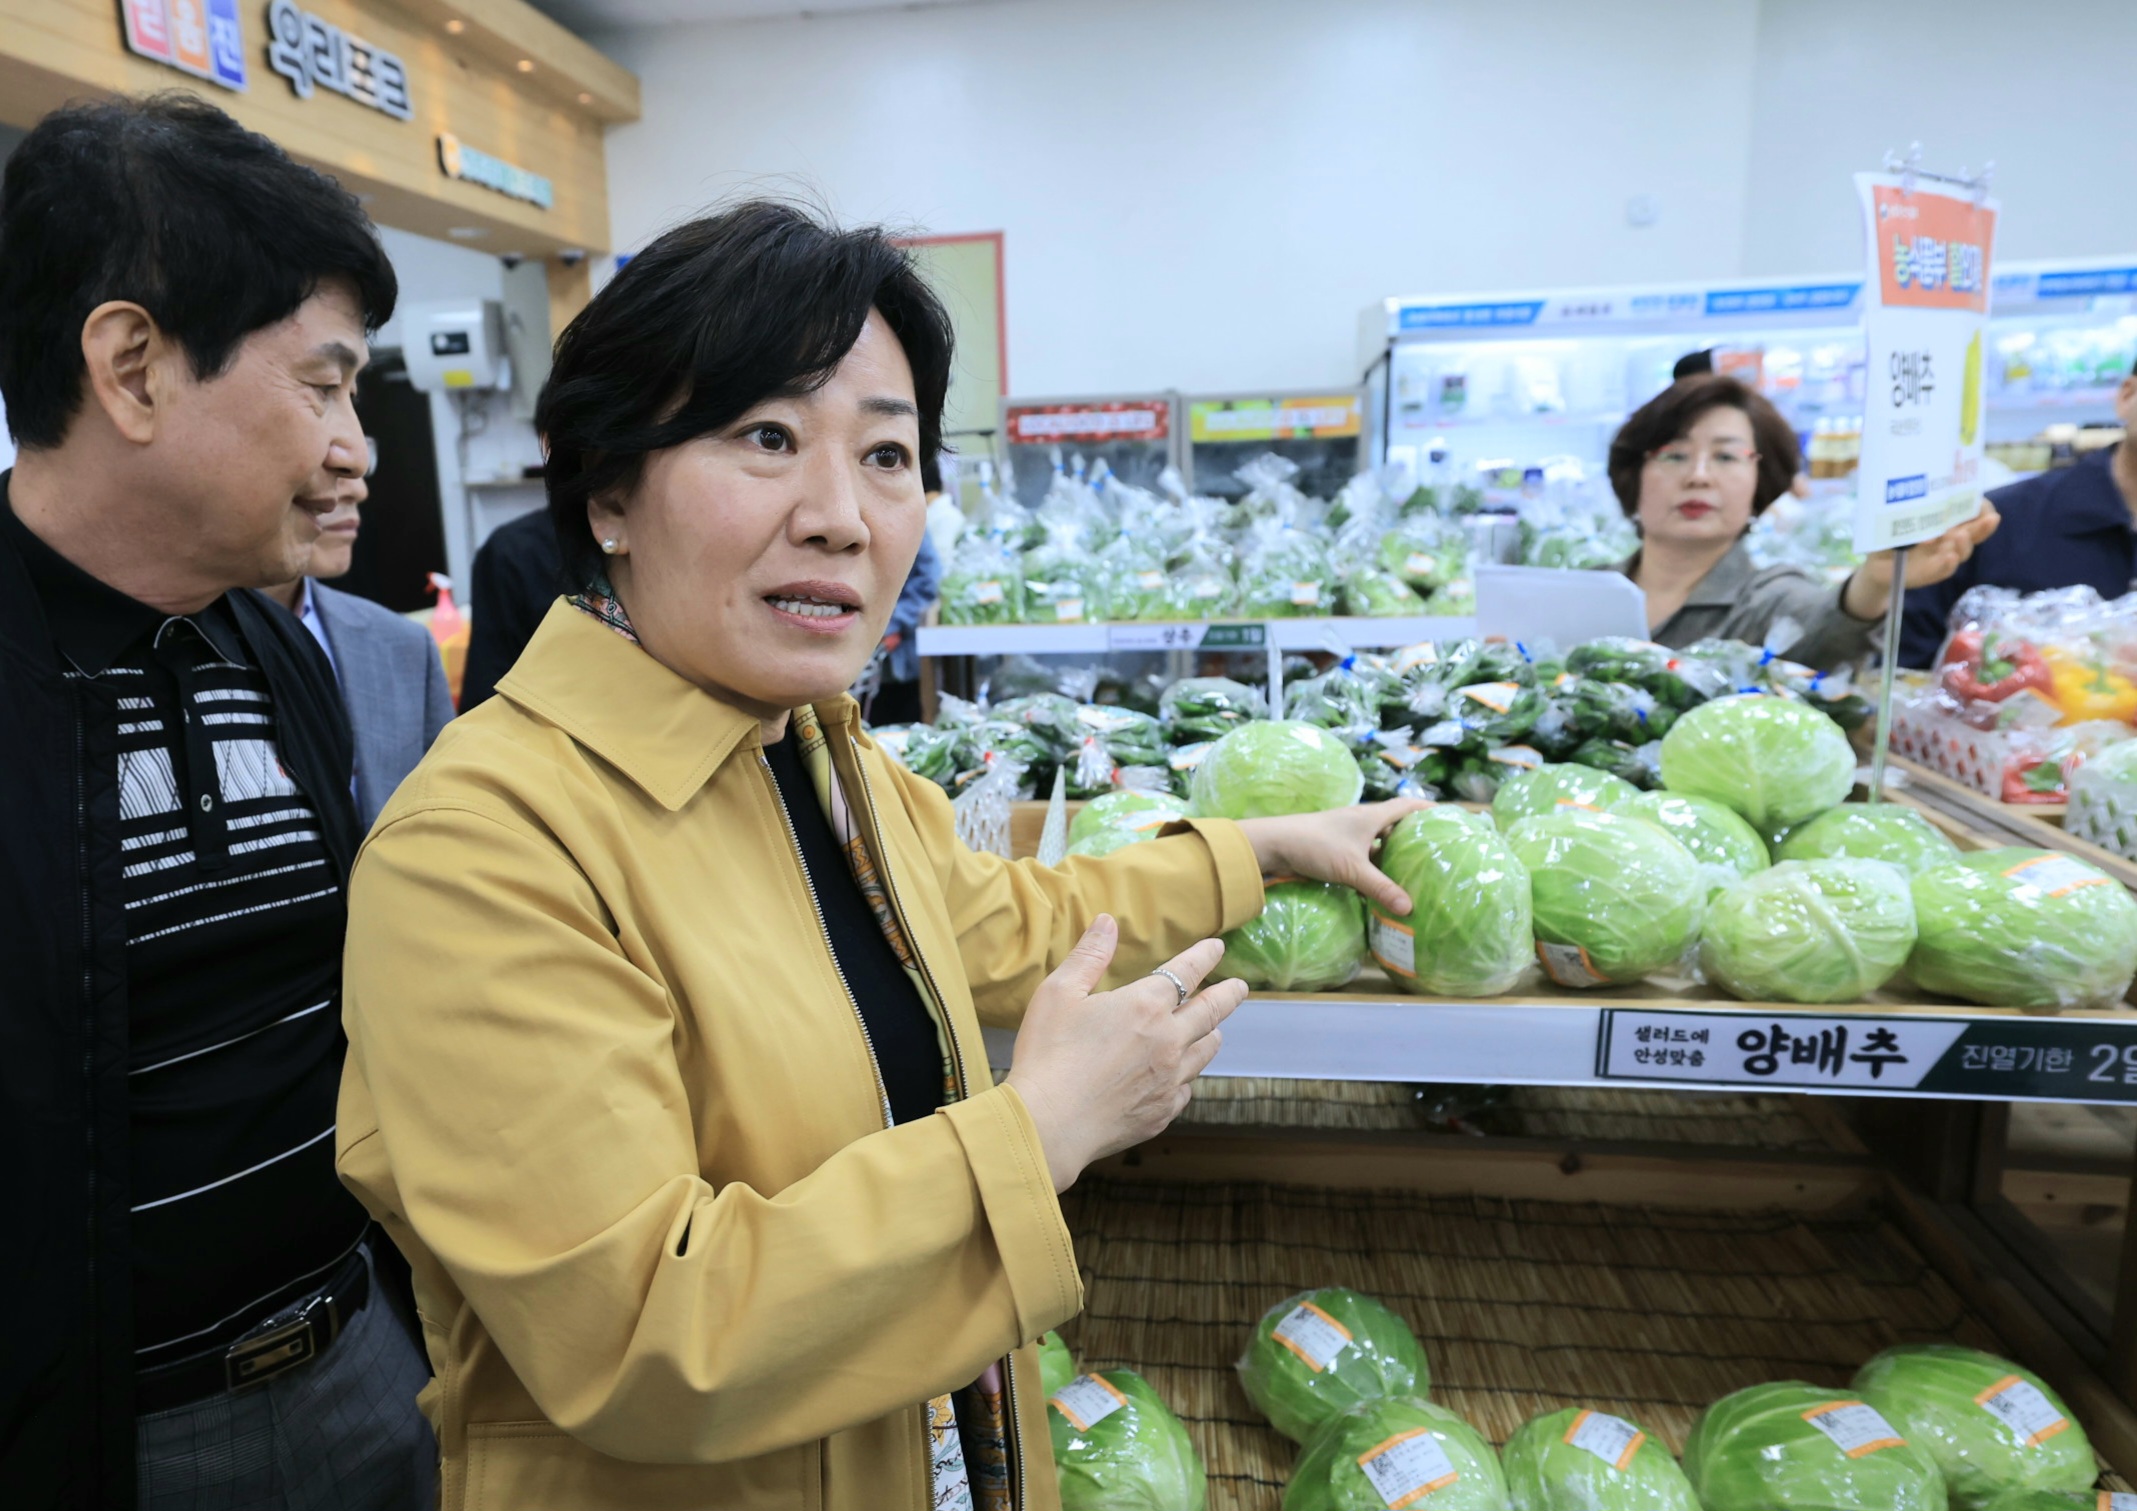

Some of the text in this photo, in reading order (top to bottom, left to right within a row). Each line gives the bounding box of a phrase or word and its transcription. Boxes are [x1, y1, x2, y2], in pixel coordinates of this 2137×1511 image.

[274, 3, 411, 114] 우리포크
[1890, 350, 1935, 408] 양배추
[1634, 1026, 1709, 1044] 샐러드에
[1634, 1047, 1706, 1067] 안성맞춤
[1736, 1023, 1909, 1079] 양배추
[1961, 1044, 2075, 1072] 진열기한
